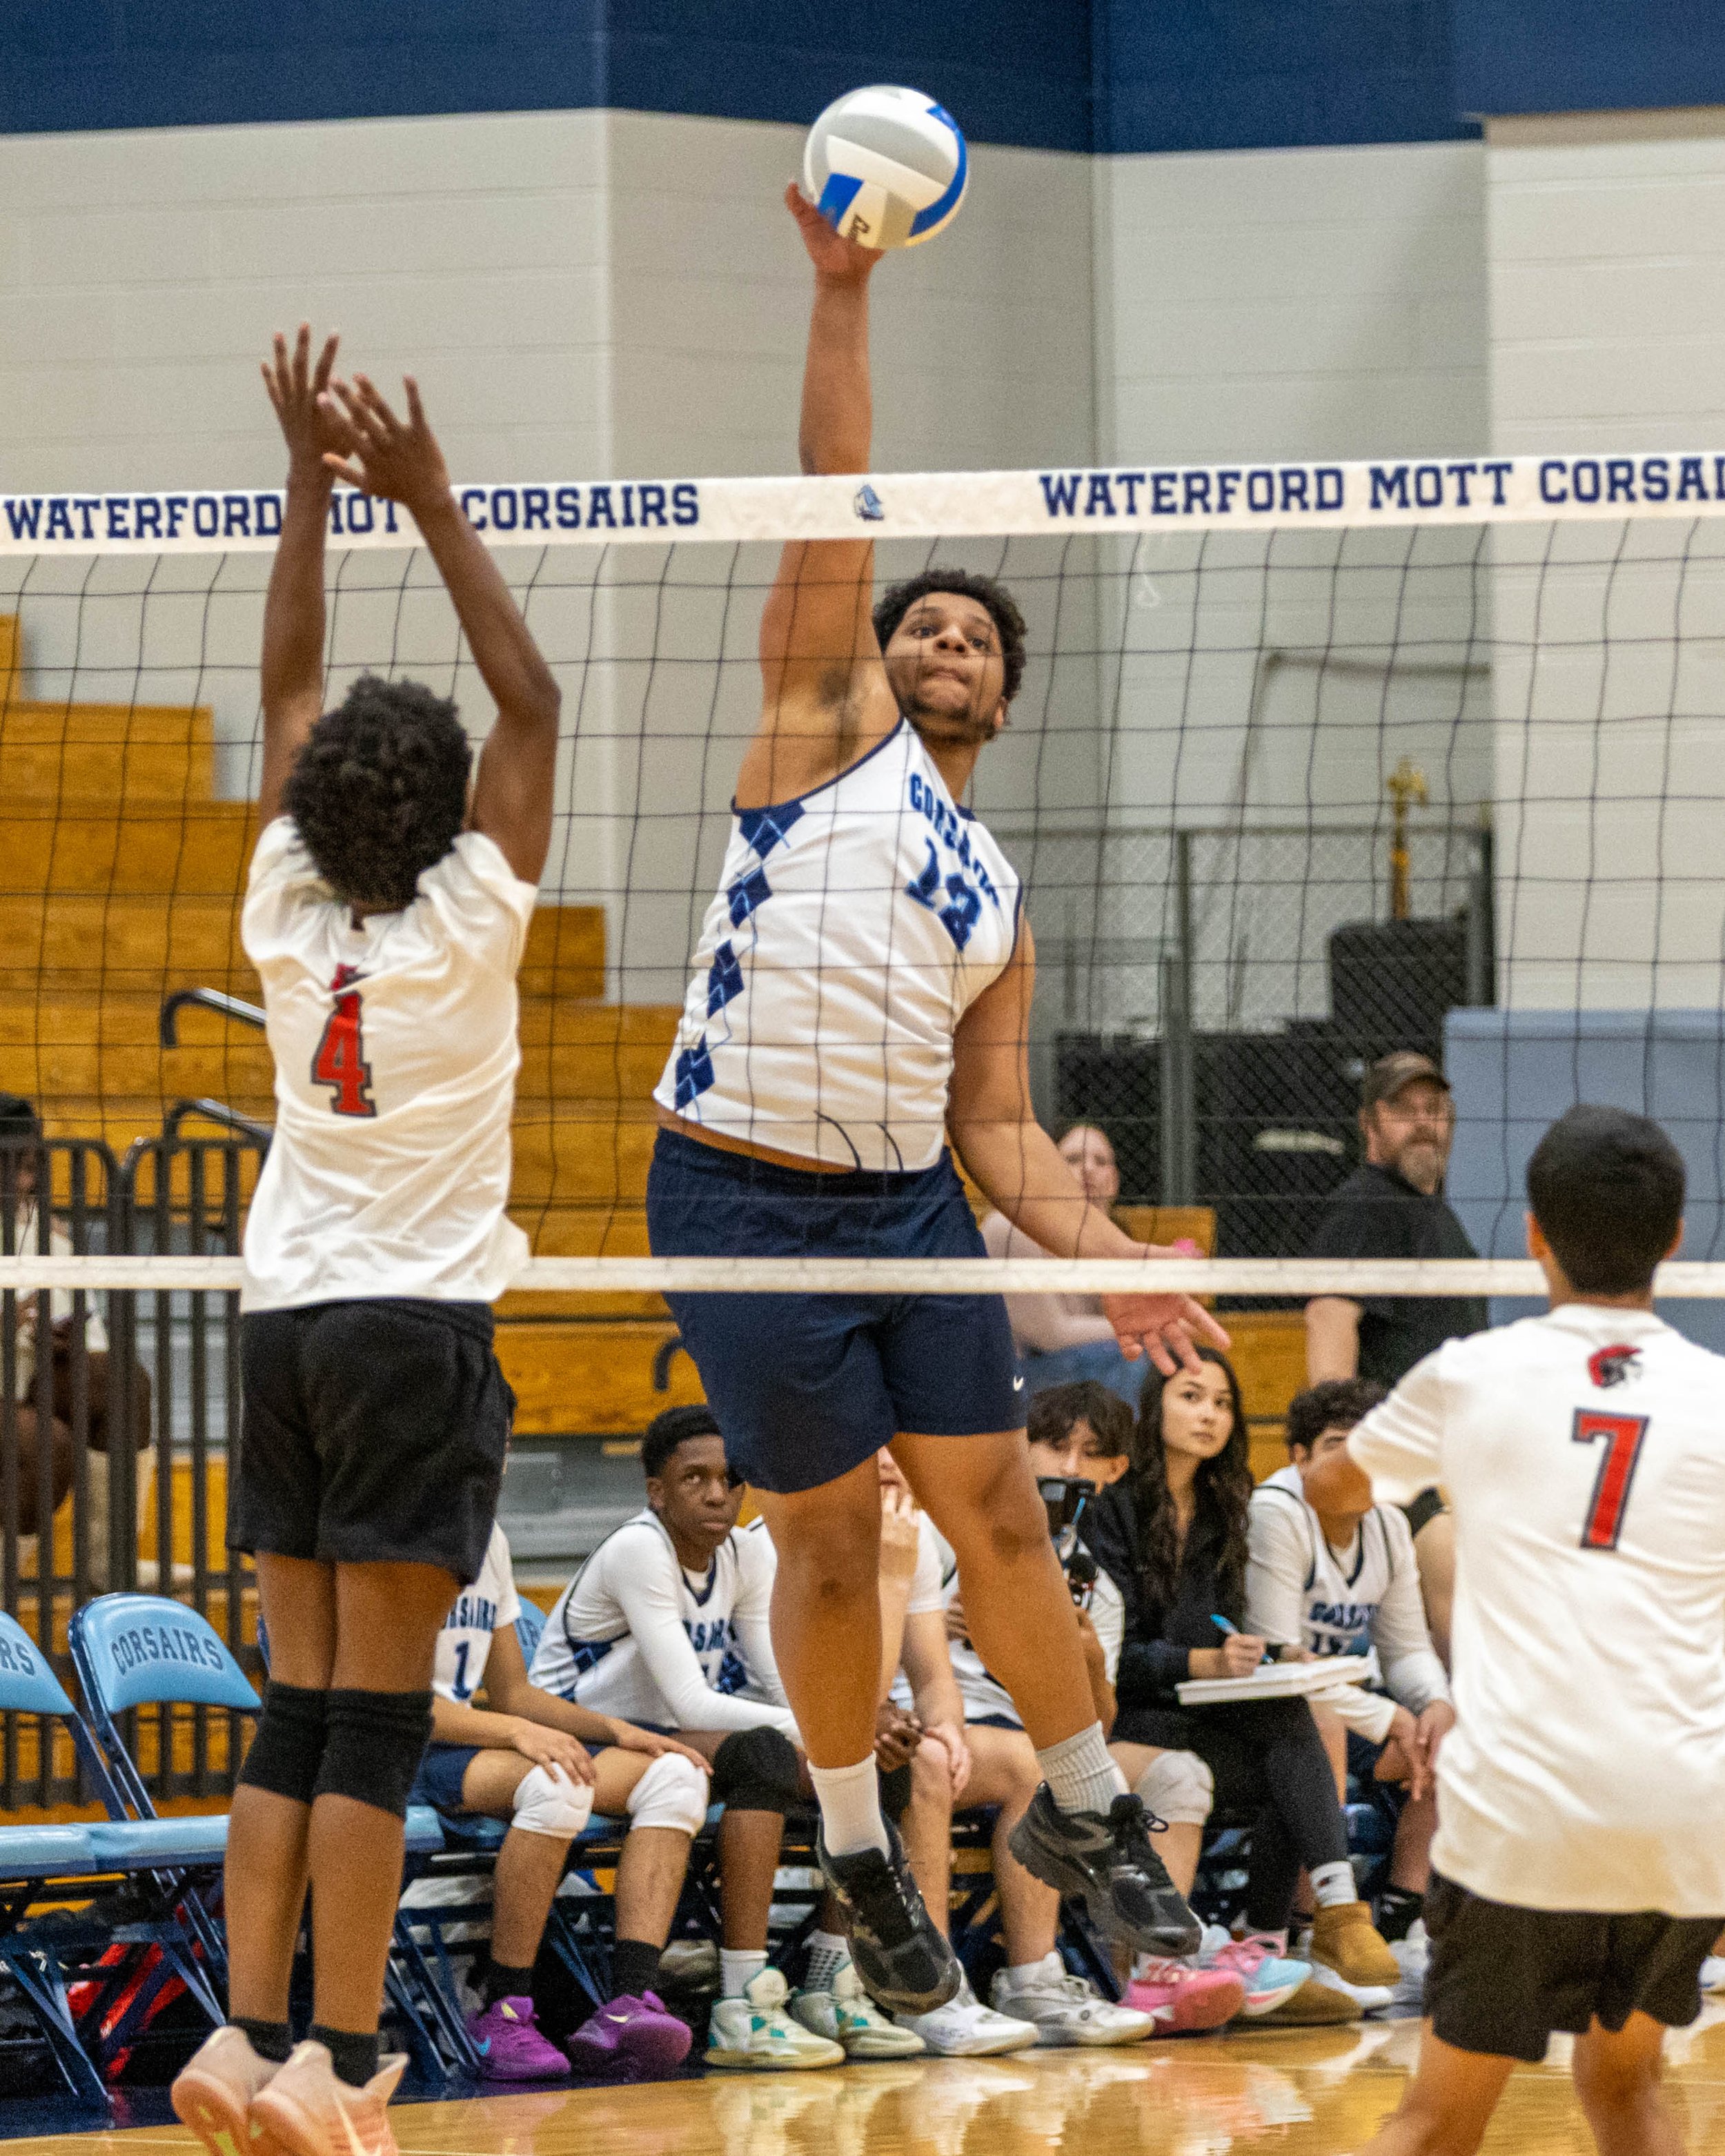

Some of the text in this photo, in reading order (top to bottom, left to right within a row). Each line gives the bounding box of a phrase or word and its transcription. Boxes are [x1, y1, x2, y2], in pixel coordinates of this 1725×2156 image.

[3, 494, 282, 540] WATERFORD
[461, 483, 700, 531] CORSAIRS
[1039, 467, 1345, 517] WATERFORD
[1368, 461, 1513, 509] MOTT
[311, 991, 377, 1118] 4
[1571, 1407, 1650, 1551] 7
[110, 1626, 224, 1676] CORSAIRS
[453, 1641, 472, 1700] 1
